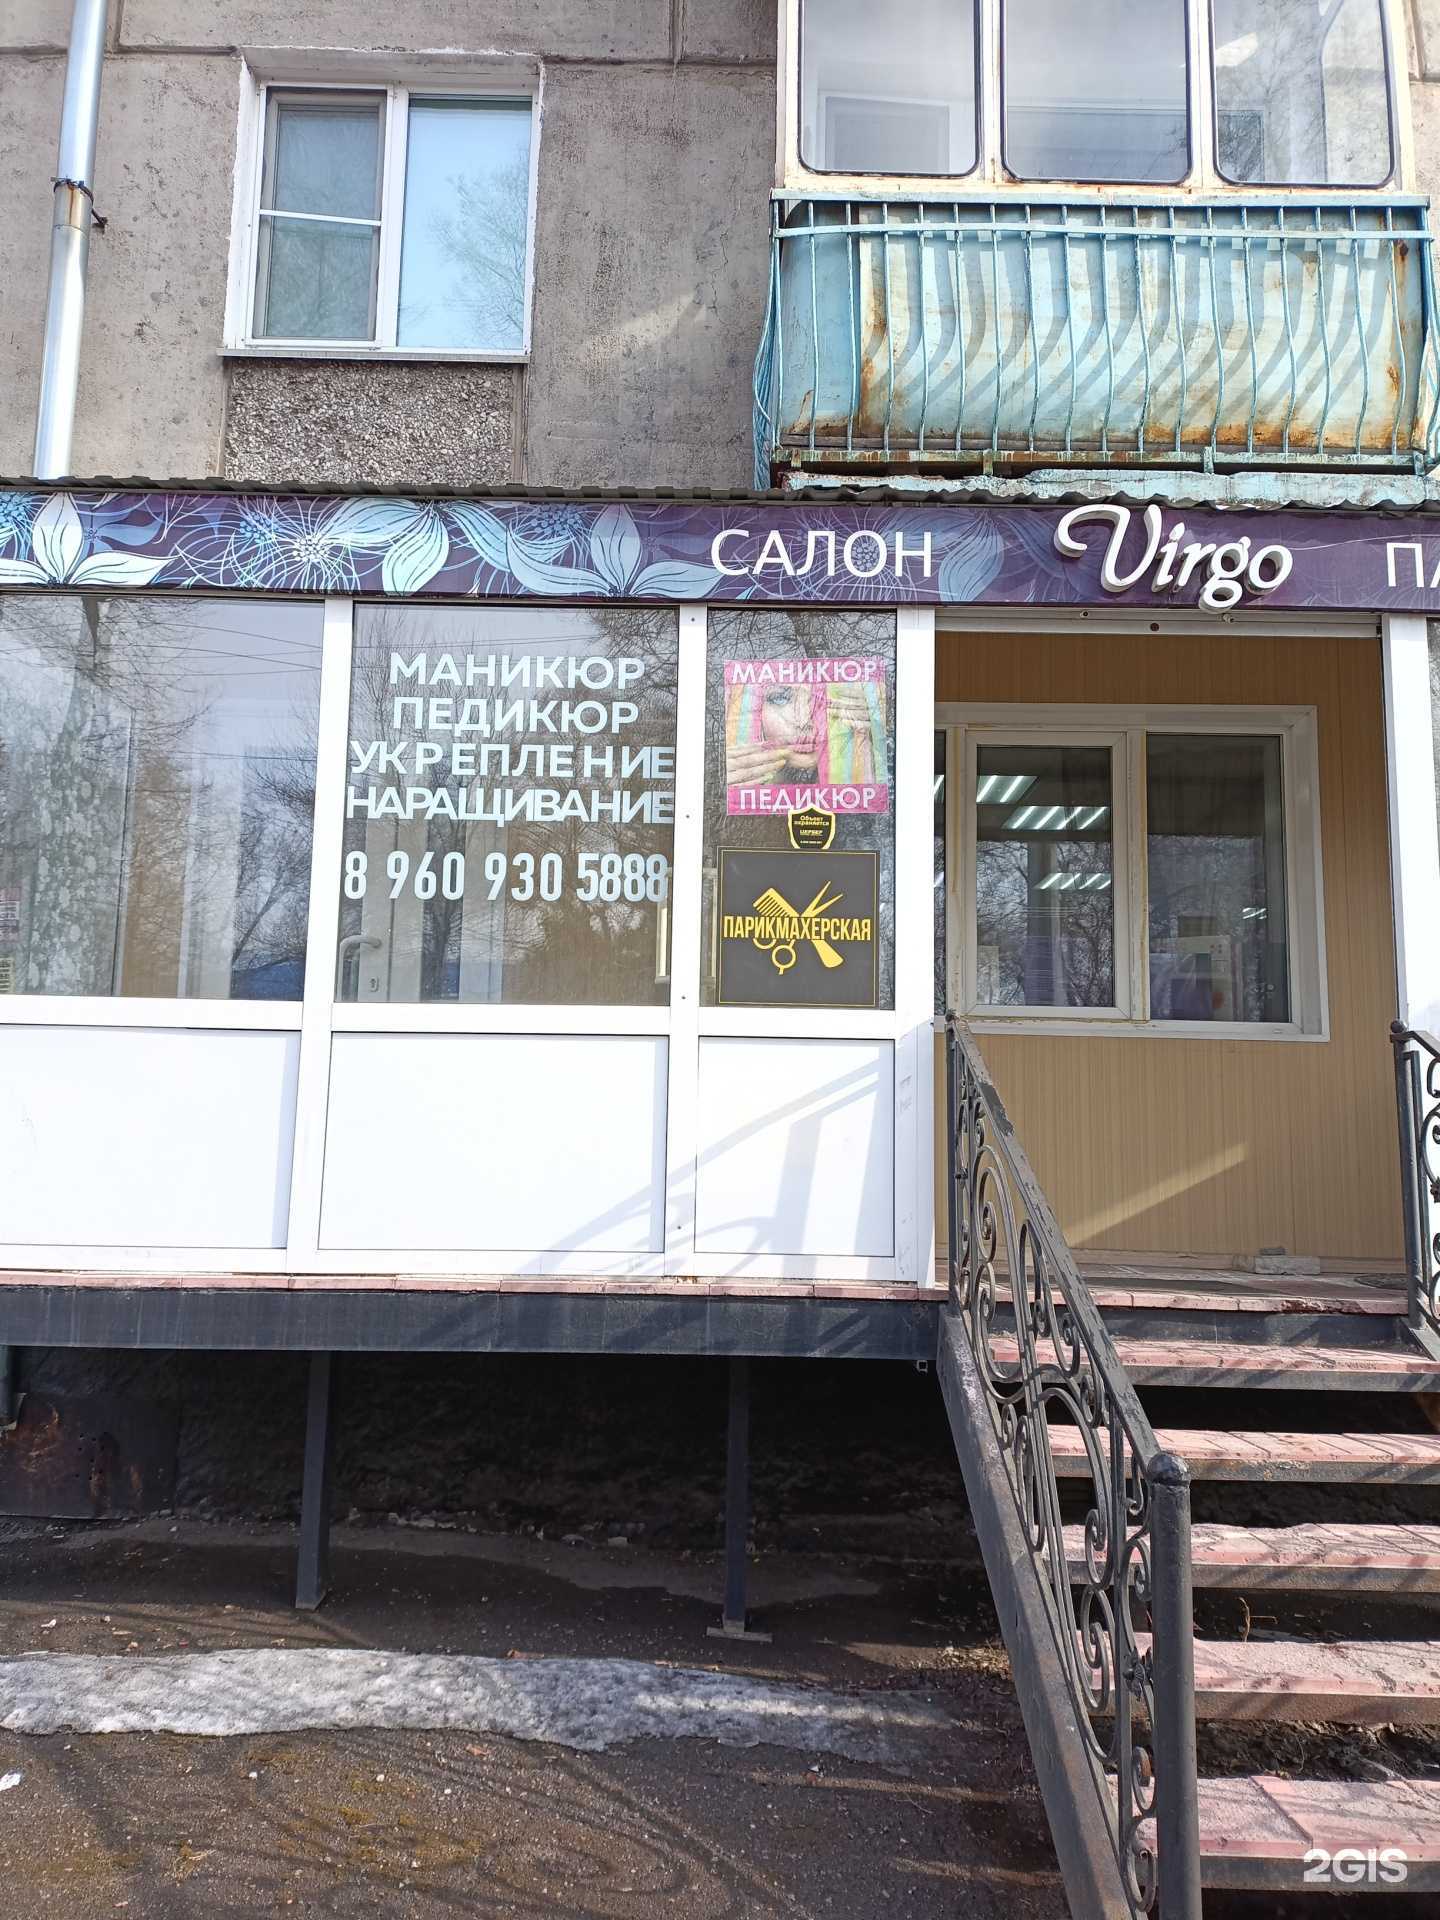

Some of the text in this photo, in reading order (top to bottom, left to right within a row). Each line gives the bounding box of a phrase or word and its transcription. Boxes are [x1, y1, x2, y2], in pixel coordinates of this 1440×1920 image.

[709, 529, 934, 579] САЛОН
[1054, 503, 1294, 614] Virgo
[389, 652, 645, 690] МАНИКЮР
[732, 660, 877, 684] МАНИКЮР
[392, 696, 639, 738] ПЕДИКЮР
[350, 740, 675, 779] УКРЕПЛЕНИЕ
[346, 786, 675, 828] НАРАЩИВАНИЕ
[739, 788, 876, 812] ПЕДИКЮР
[344, 851, 668, 902] 8 960 930 5888
[723, 915, 871, 941] ПАРИКМАХЕРСКАЯ
